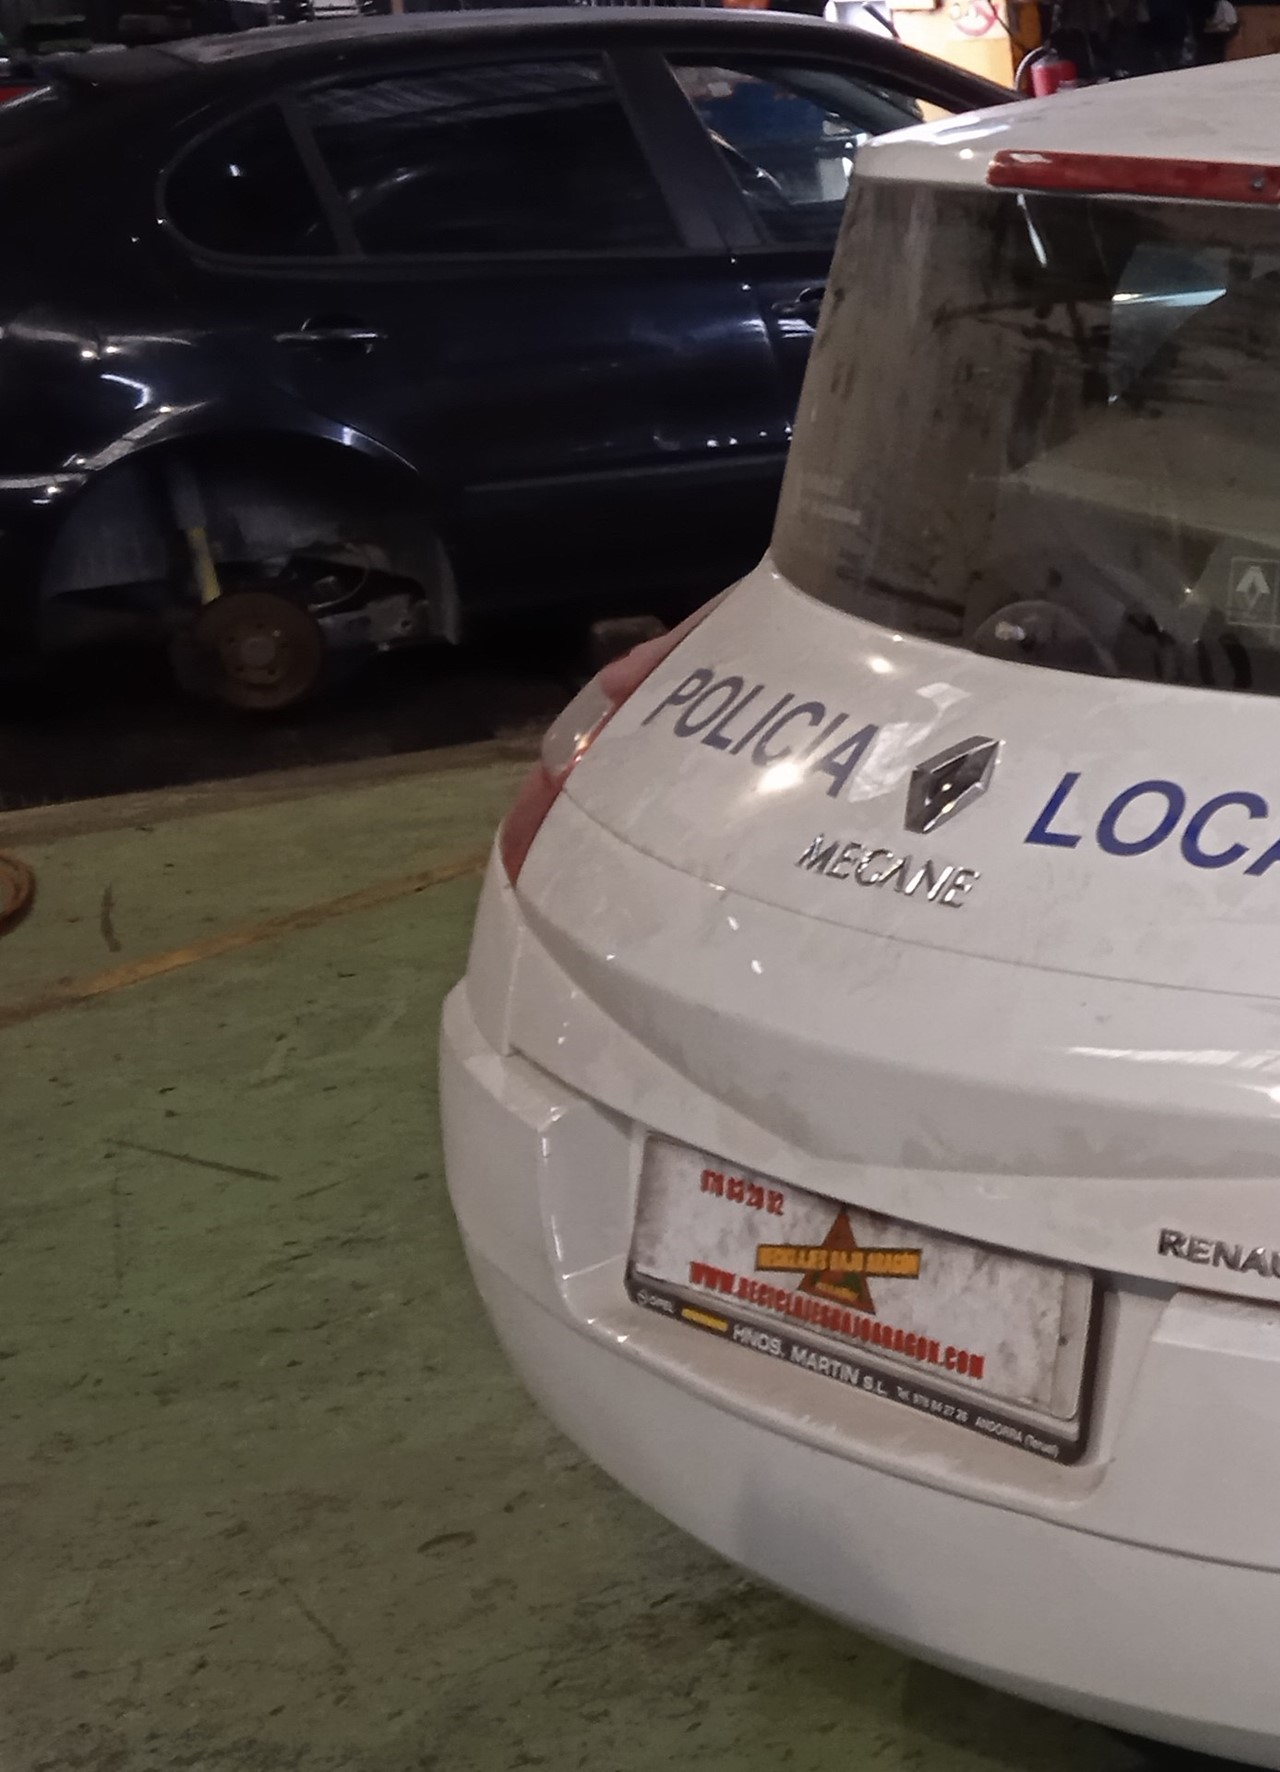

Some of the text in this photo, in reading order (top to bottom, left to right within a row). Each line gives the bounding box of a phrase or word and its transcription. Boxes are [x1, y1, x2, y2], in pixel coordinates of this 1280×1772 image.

[641, 668, 880, 799] POLICIA
[732, 1323, 786, 1359] HNOS.
[789, 1344, 861, 1387] MARTIN
